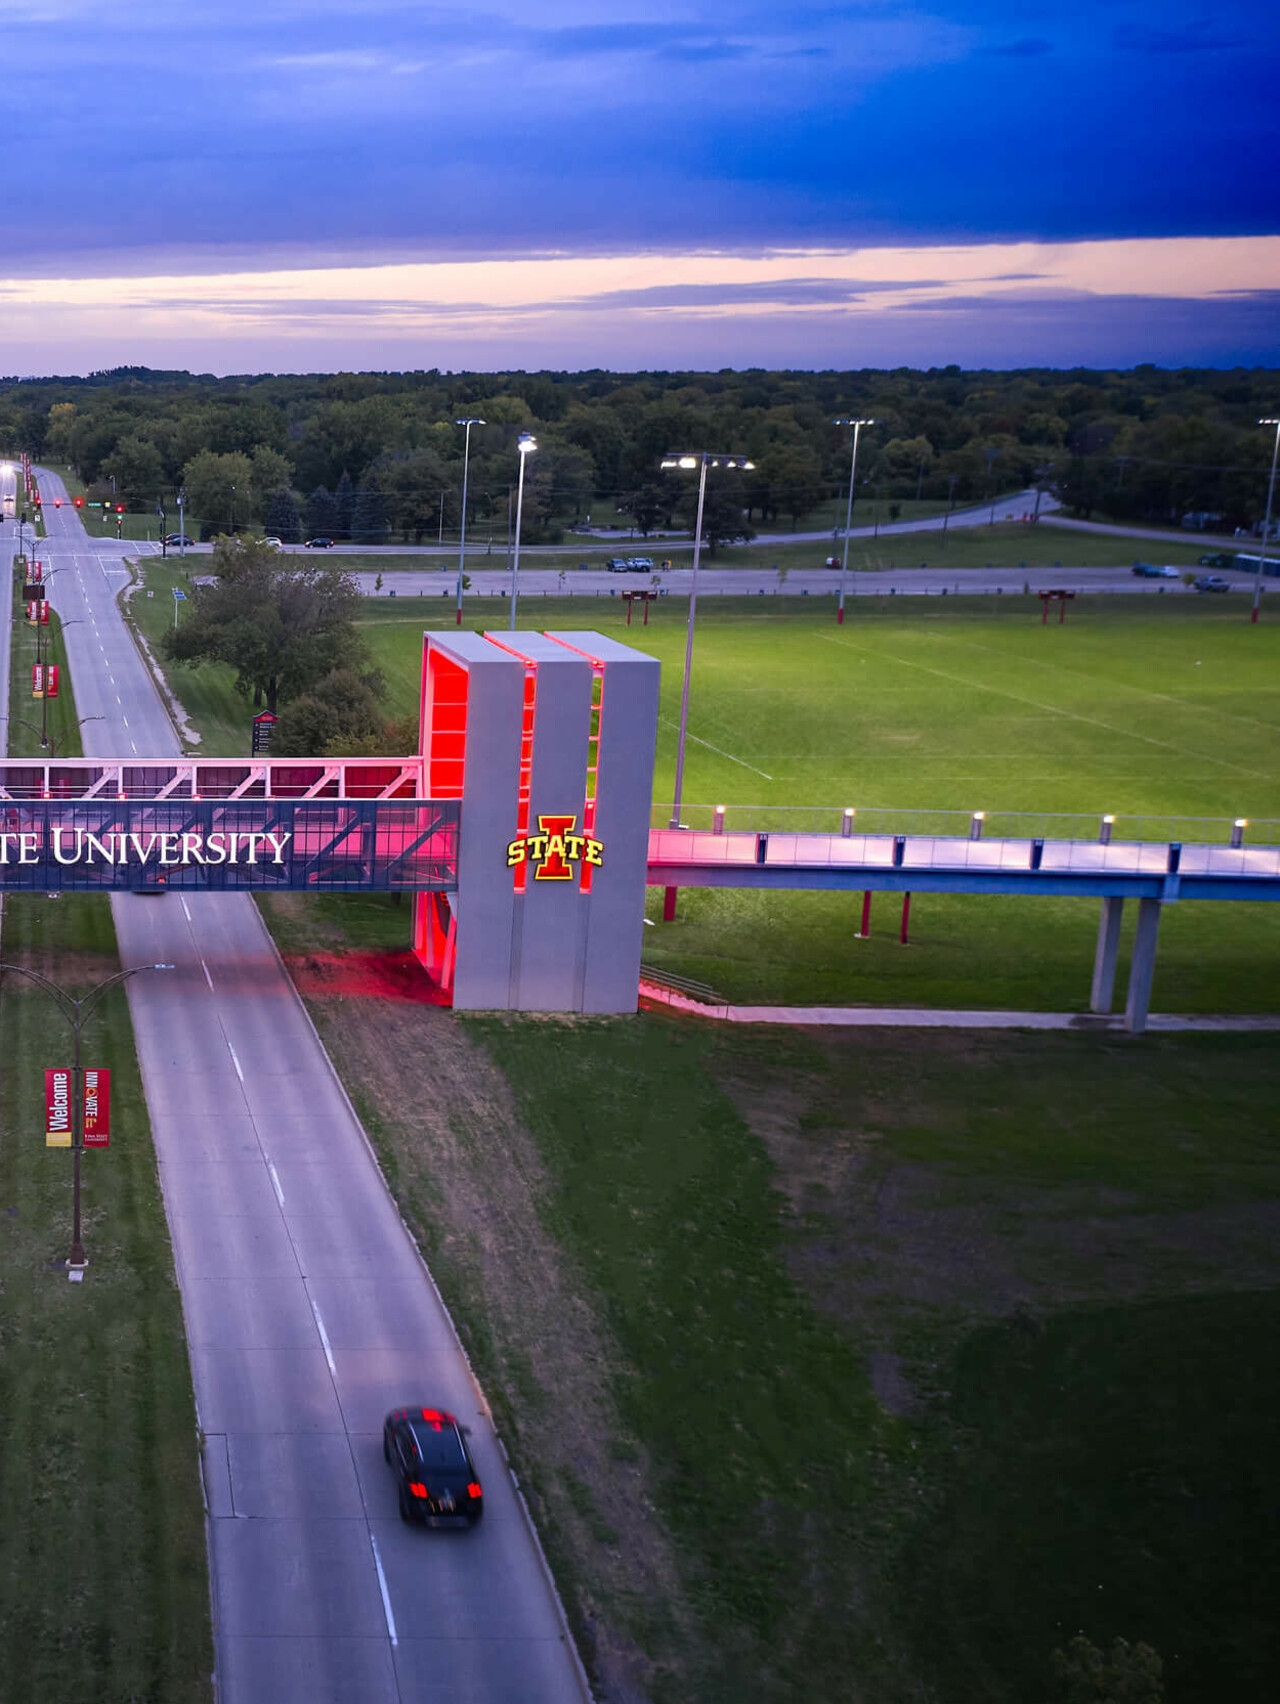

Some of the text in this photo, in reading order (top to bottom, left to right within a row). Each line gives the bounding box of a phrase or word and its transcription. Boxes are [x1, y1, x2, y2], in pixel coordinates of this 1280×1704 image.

[50, 827, 293, 865] UNIVERSITY
[507, 834, 604, 867] STATE
[49, 1073, 68, 1131] Welcome
